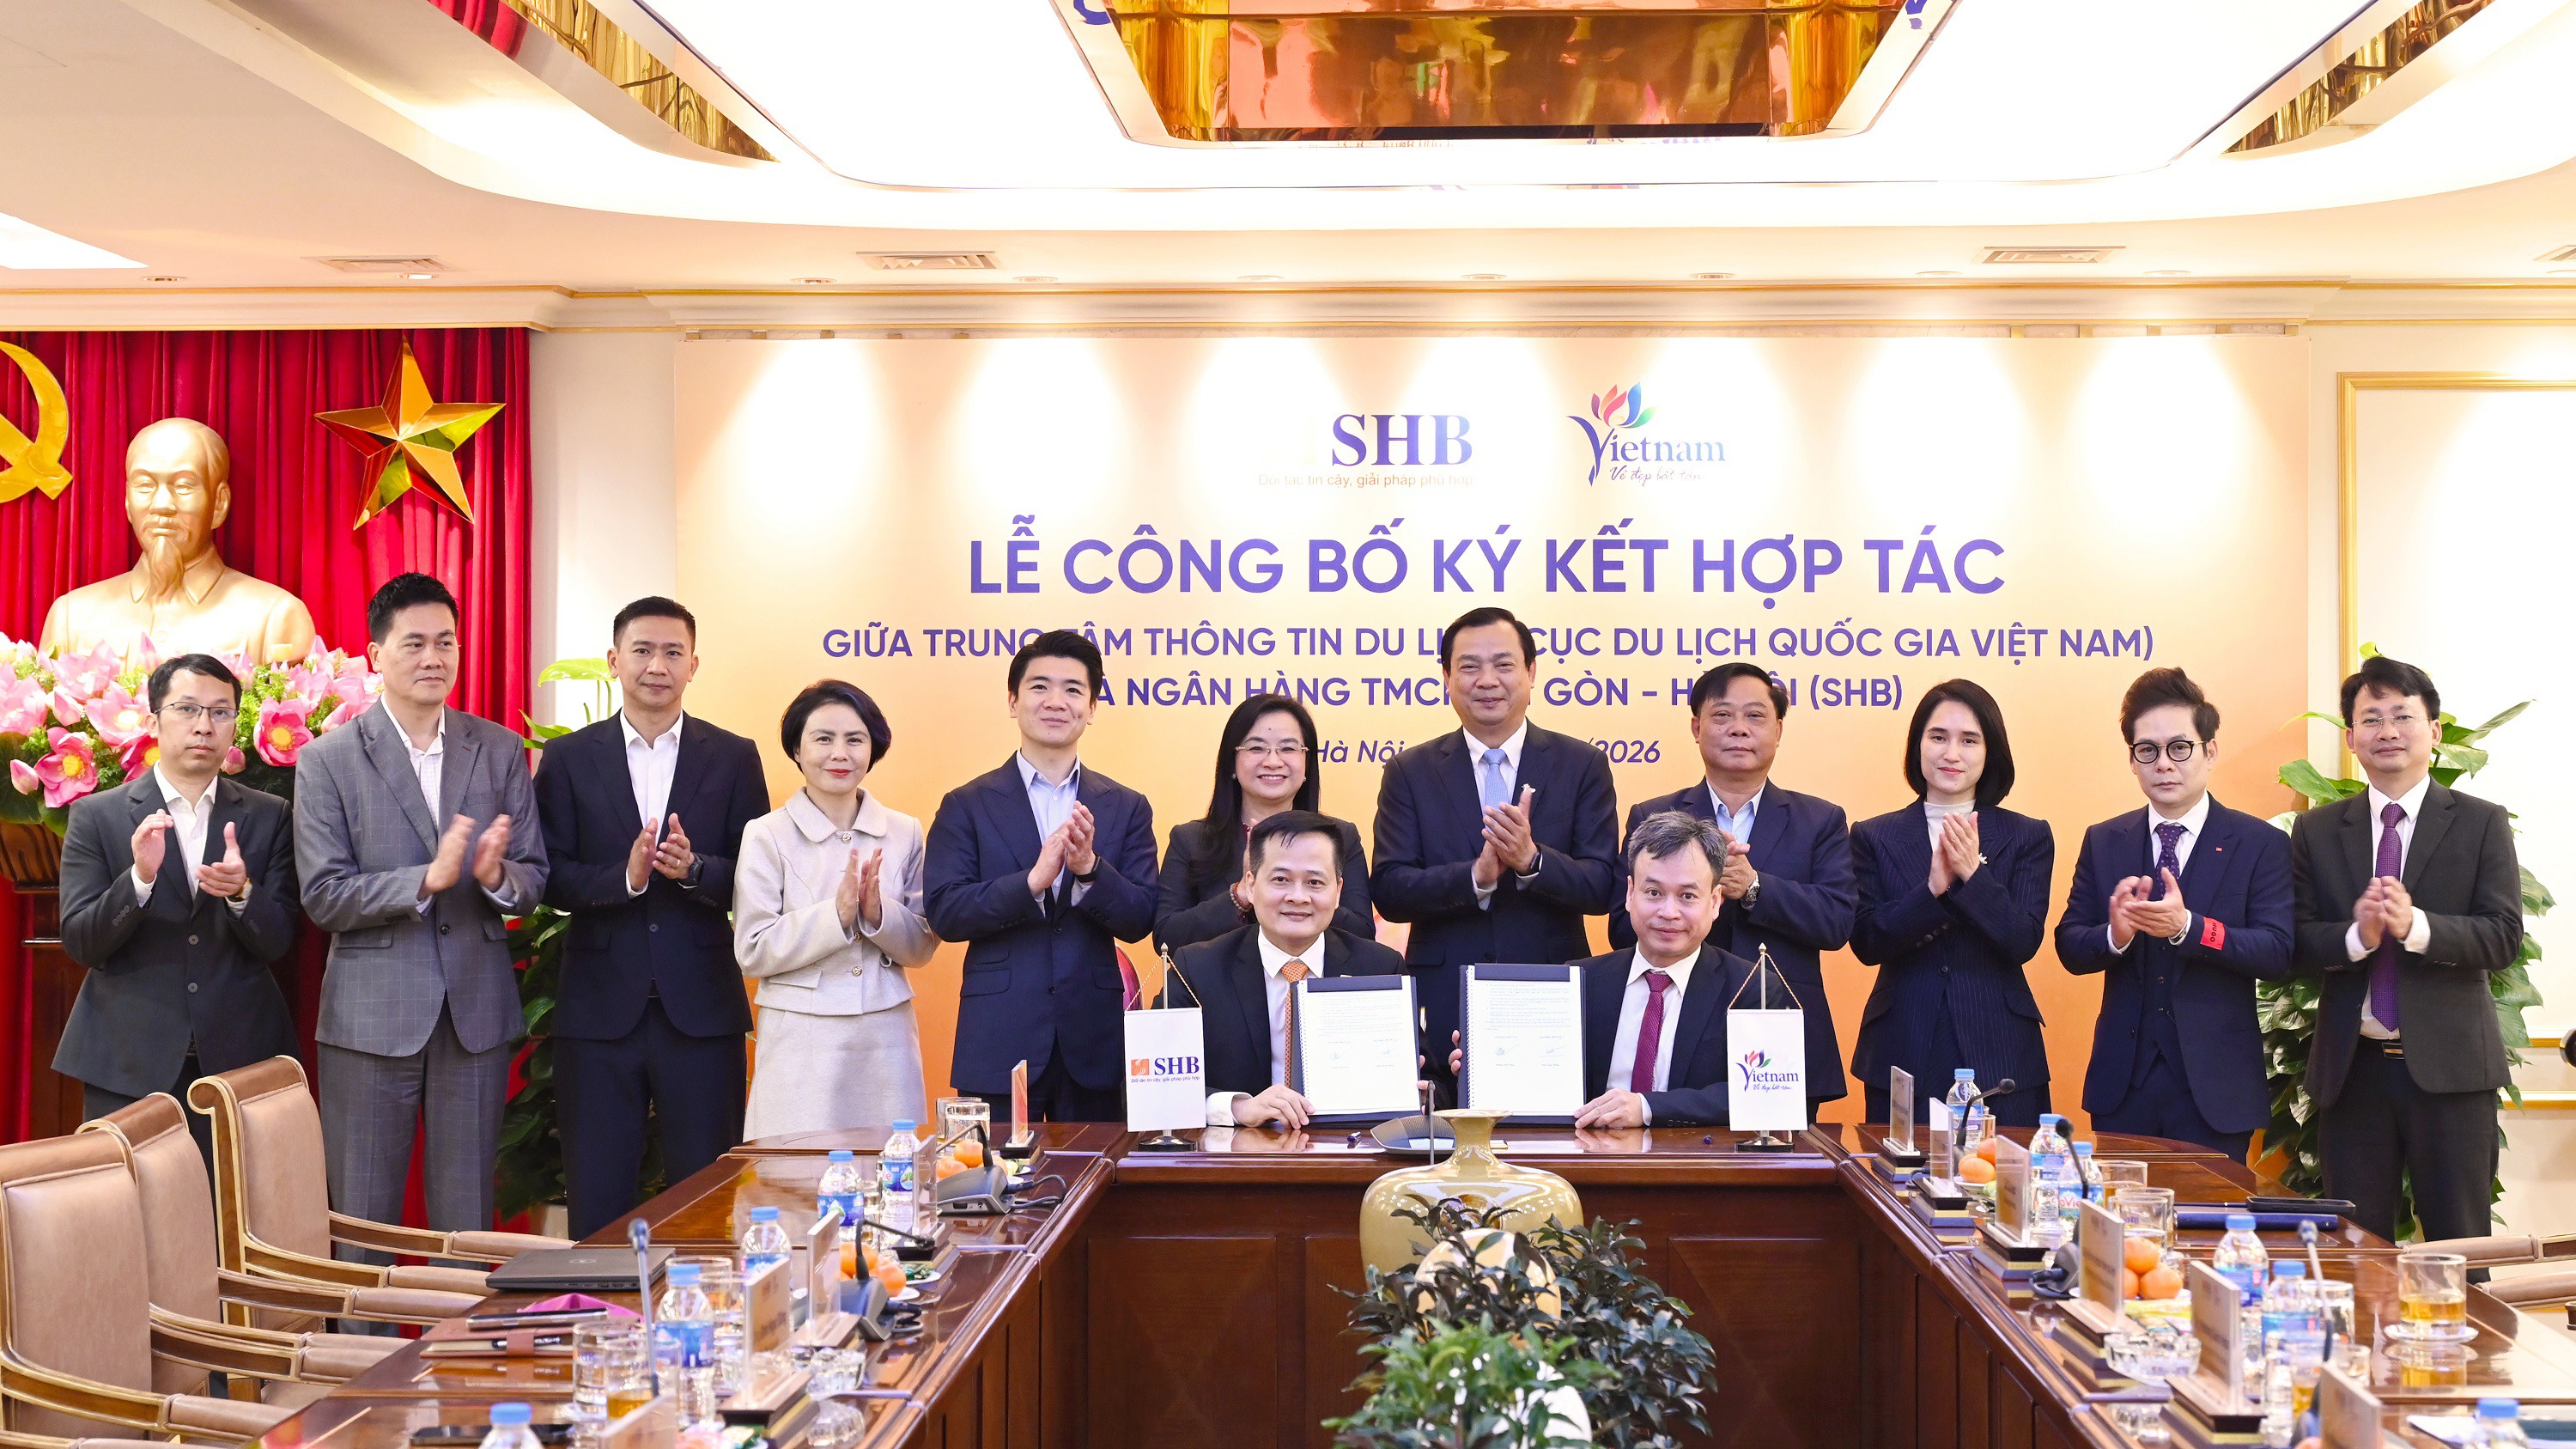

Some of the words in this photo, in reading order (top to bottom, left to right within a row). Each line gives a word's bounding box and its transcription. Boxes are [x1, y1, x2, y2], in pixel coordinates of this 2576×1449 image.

[1332, 414, 1473, 466] SHB
[1566, 416, 1726, 487] Vietnam
[1308, 474, 1323, 485] tin
[1327, 473, 1352, 489] cậy,
[1357, 472, 1380, 489] giải
[1383, 472, 1416, 488] pháp
[971, 514, 1040, 594] LỄ
[1063, 524, 1284, 594] CÔNG
[1309, 518, 1408, 594] BỐ
[1433, 524, 1522, 593] KÝ
[1546, 518, 1669, 593] KẾT
[1692, 533, 1843, 610] HỢP
[1863, 525, 2005, 594] TÁC
[823, 621, 912, 658] GIỮA
[1058, 621, 1131, 656] ÂM
[1144, 619, 1276, 656] THÔNG
[1287, 628, 1341, 656] TIN
[1356, 628, 1405, 656] DU
[1614, 628, 1663, 656] DU
[1677, 627, 1756, 664] LỊCH
[1768, 617, 1882, 657] QUỐC
[1894, 628, 1960, 657] GIA
[1971, 621, 2049, 666] VIỆT
[2061, 625, 2154, 661] NAM)
[1127, 670, 1231, 706] NGÂN
[1245, 670, 1351, 706] HÀNG
[1362, 678, 1451, 706] TMC
[1544, 670, 1628, 707] GÒN
[1810, 674, 1903, 710] (SHB)
[2209, 922, 2218, 942] HUGO
[1154, 1056, 1200, 1075] SHB
[1735, 1062, 1799, 1093] Vietnam
